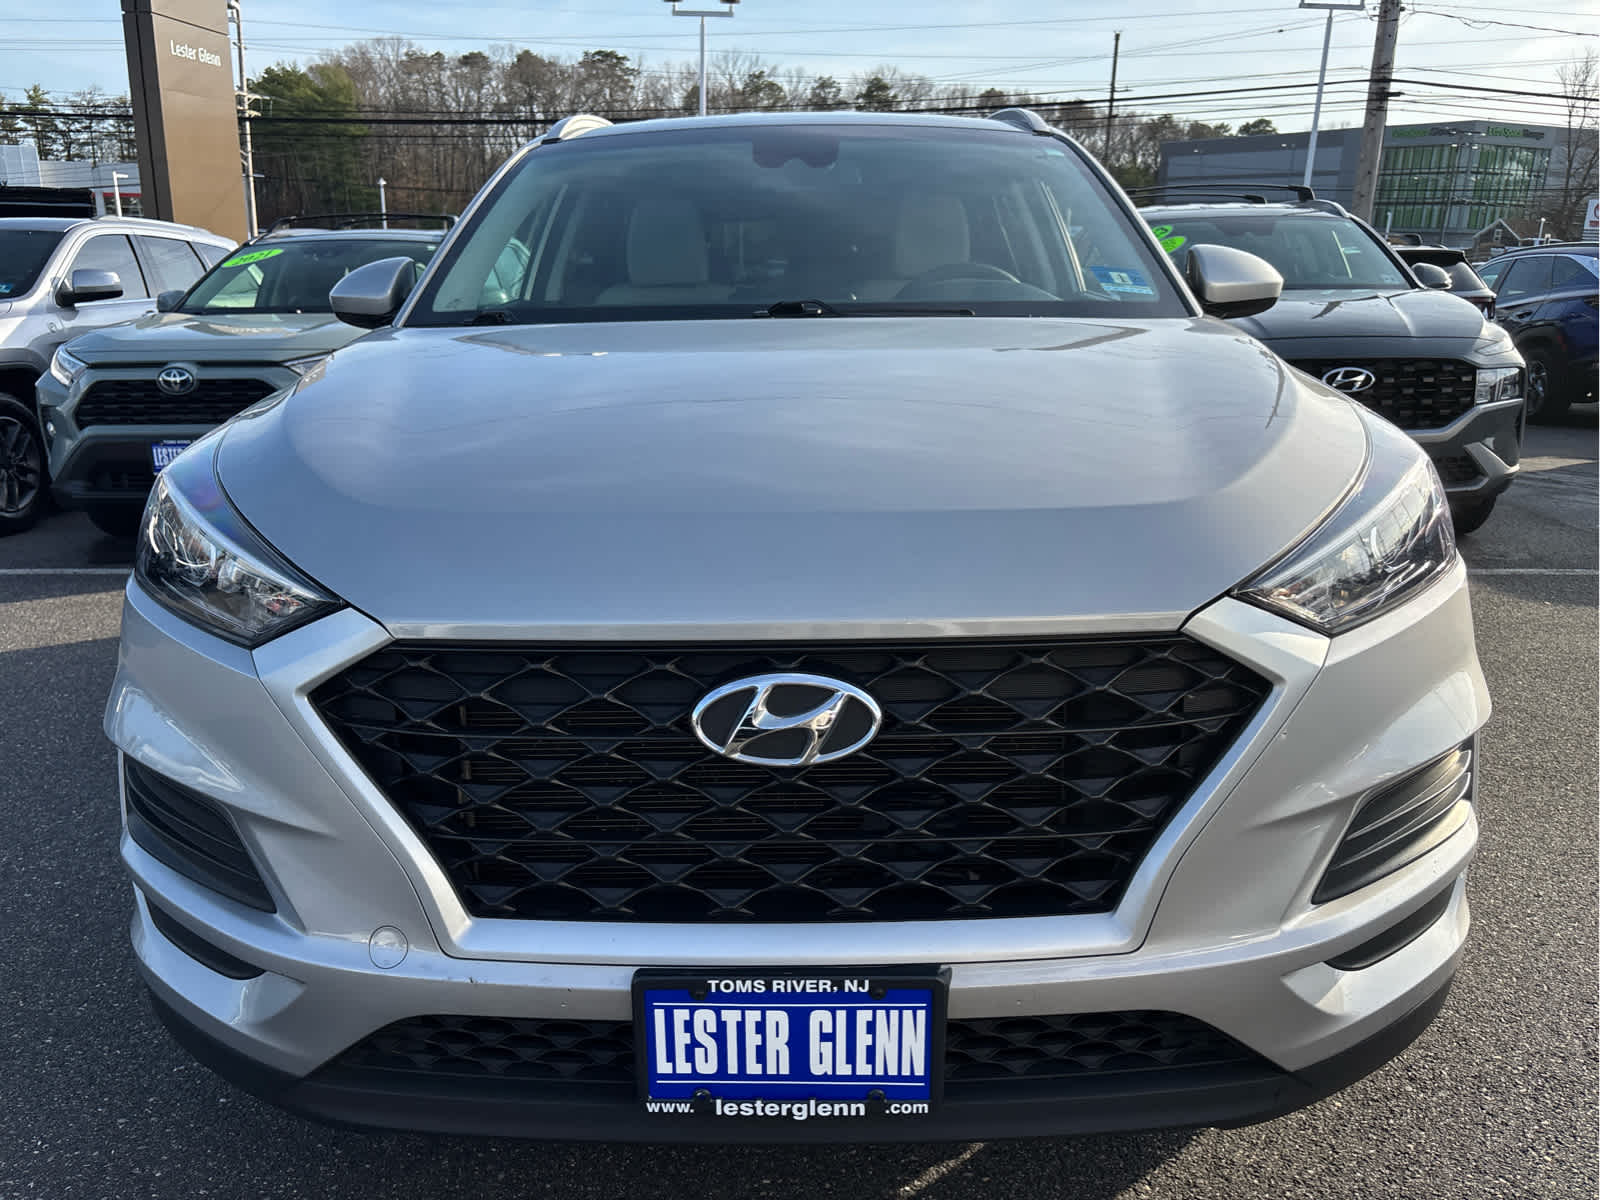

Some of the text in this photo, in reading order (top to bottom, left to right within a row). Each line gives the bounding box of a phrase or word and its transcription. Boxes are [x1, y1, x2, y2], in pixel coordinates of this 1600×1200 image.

[170, 39, 222, 67] Lester Glenn
[707, 979, 870, 993] TOMS RIVER, NJ
[653, 1008, 927, 1076] LESTER GLENN
[646, 1099, 929, 1121] www. lesterglenn .com
